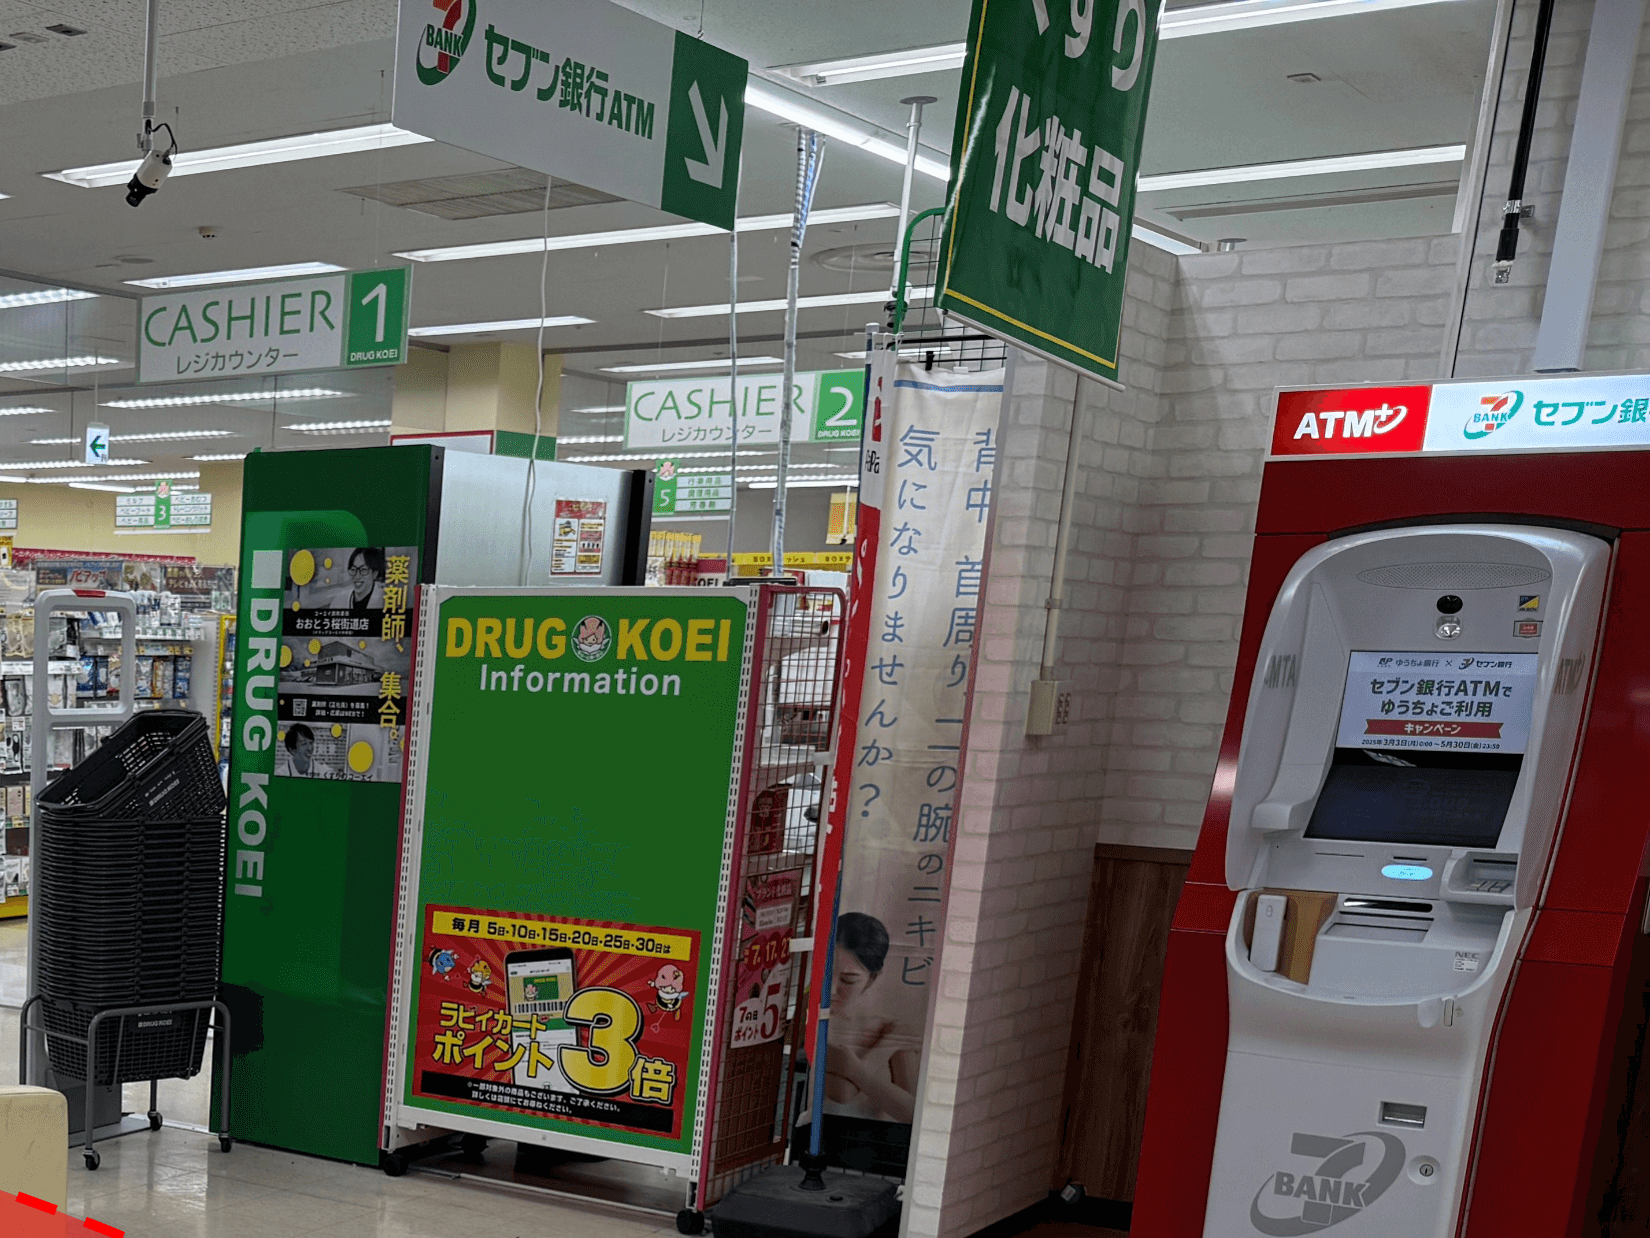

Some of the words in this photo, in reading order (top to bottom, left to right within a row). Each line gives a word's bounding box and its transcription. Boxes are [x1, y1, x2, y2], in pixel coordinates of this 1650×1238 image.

[426, 23, 464, 57] BANK
[484, 24, 655, 140] セブン銀行ATM
[989, 85, 1125, 275] 化粧品
[144, 289, 336, 348] CASHIER
[361, 282, 387, 344] 1
[177, 347, 299, 375] レジカウンター
[350, 350, 375, 362] DRUG
[375, 348, 398, 359] KOEI
[634, 384, 806, 422] CASHIER
[824, 385, 858, 427] 2
[1473, 412, 1508, 424] BANK
[1533, 397, 1650, 427] セブン銀
[661, 424, 773, 443] レジカウンター
[818, 429, 840, 438] DRUG
[840, 428, 861, 437] KOEI
[158, 505, 166, 520] 3
[660, 489, 671, 506] 5
[381, 555, 410, 653] 薬剤師、
[296, 618, 370, 630] おおとう桜街道店
[857, 424, 940, 818] 気になりませんか?
[446, 617, 567, 660] DRUG
[616, 618, 732, 662] KOEI
[243, 598, 280, 752] DRUG
[1396, 659, 1440, 668] ゆうちょ銀行
[1476, 660, 1512, 668] セブン銀行
[480, 664, 681, 696] Information
[1370, 677, 1512, 698] セブン銀行ATMで
[378, 671, 402, 740] 集合。
[1380, 699, 1493, 717] ゆうちょご利用
[1404, 722, 1461, 734] キャンペーン
[234, 771, 270, 897] KOEI
[451, 917, 481, 934] 毎月
[1455, 951, 1480, 960] NEC
[734, 1025, 759, 1042] ポイント
[432, 1030, 555, 1079] ポイント
[631, 1057, 676, 1102] 倍
[1273, 1171, 1370, 1209] BANK
